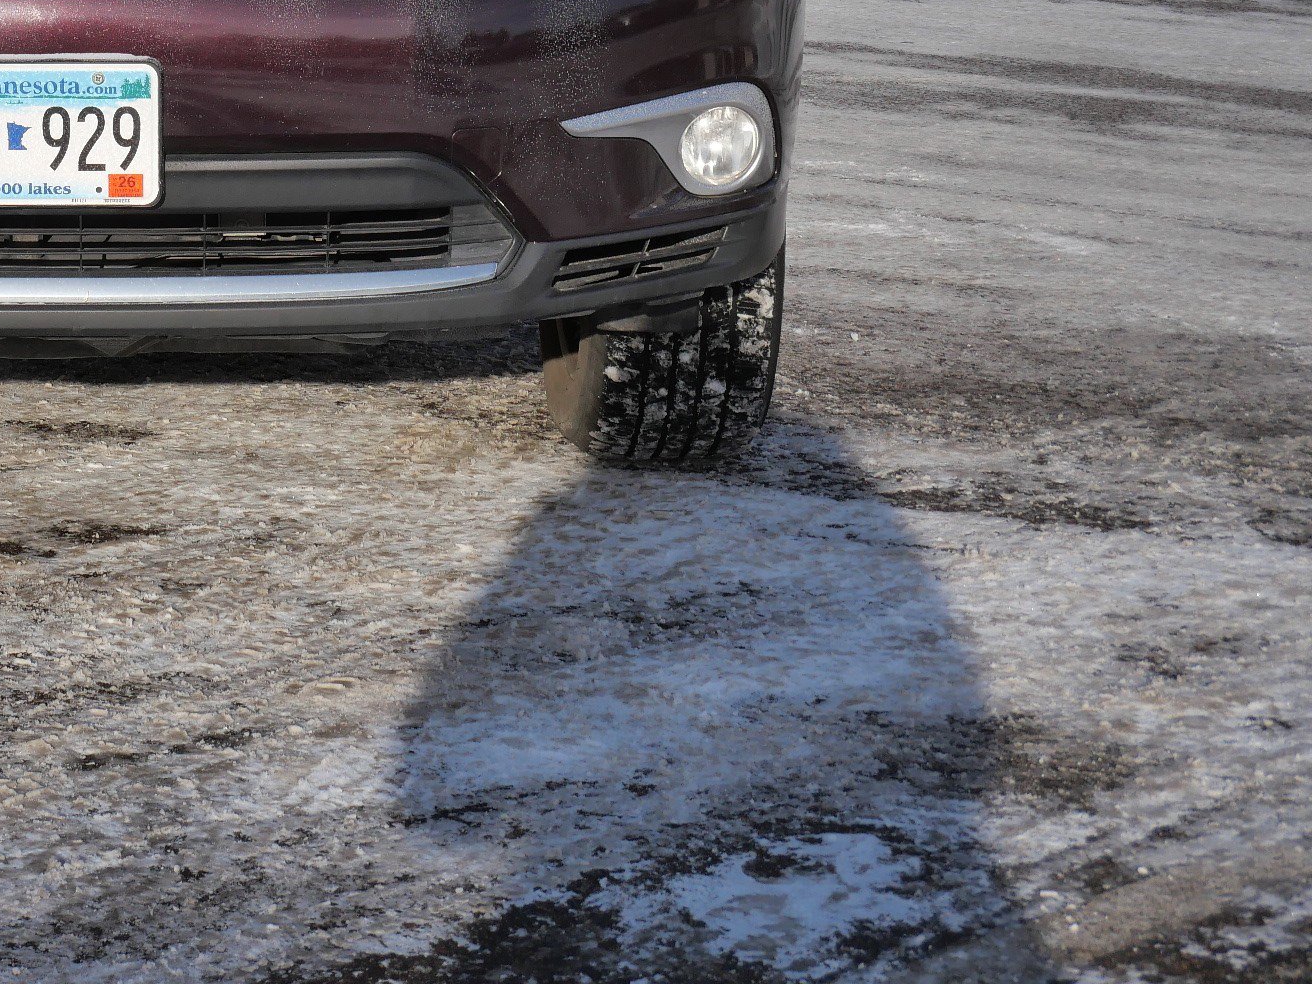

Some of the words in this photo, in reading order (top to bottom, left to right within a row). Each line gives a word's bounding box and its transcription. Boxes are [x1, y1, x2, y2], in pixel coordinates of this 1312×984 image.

[42, 106, 141, 172] 929
[28, 182, 72, 196] lakes
[118, 176, 136, 188] 26
